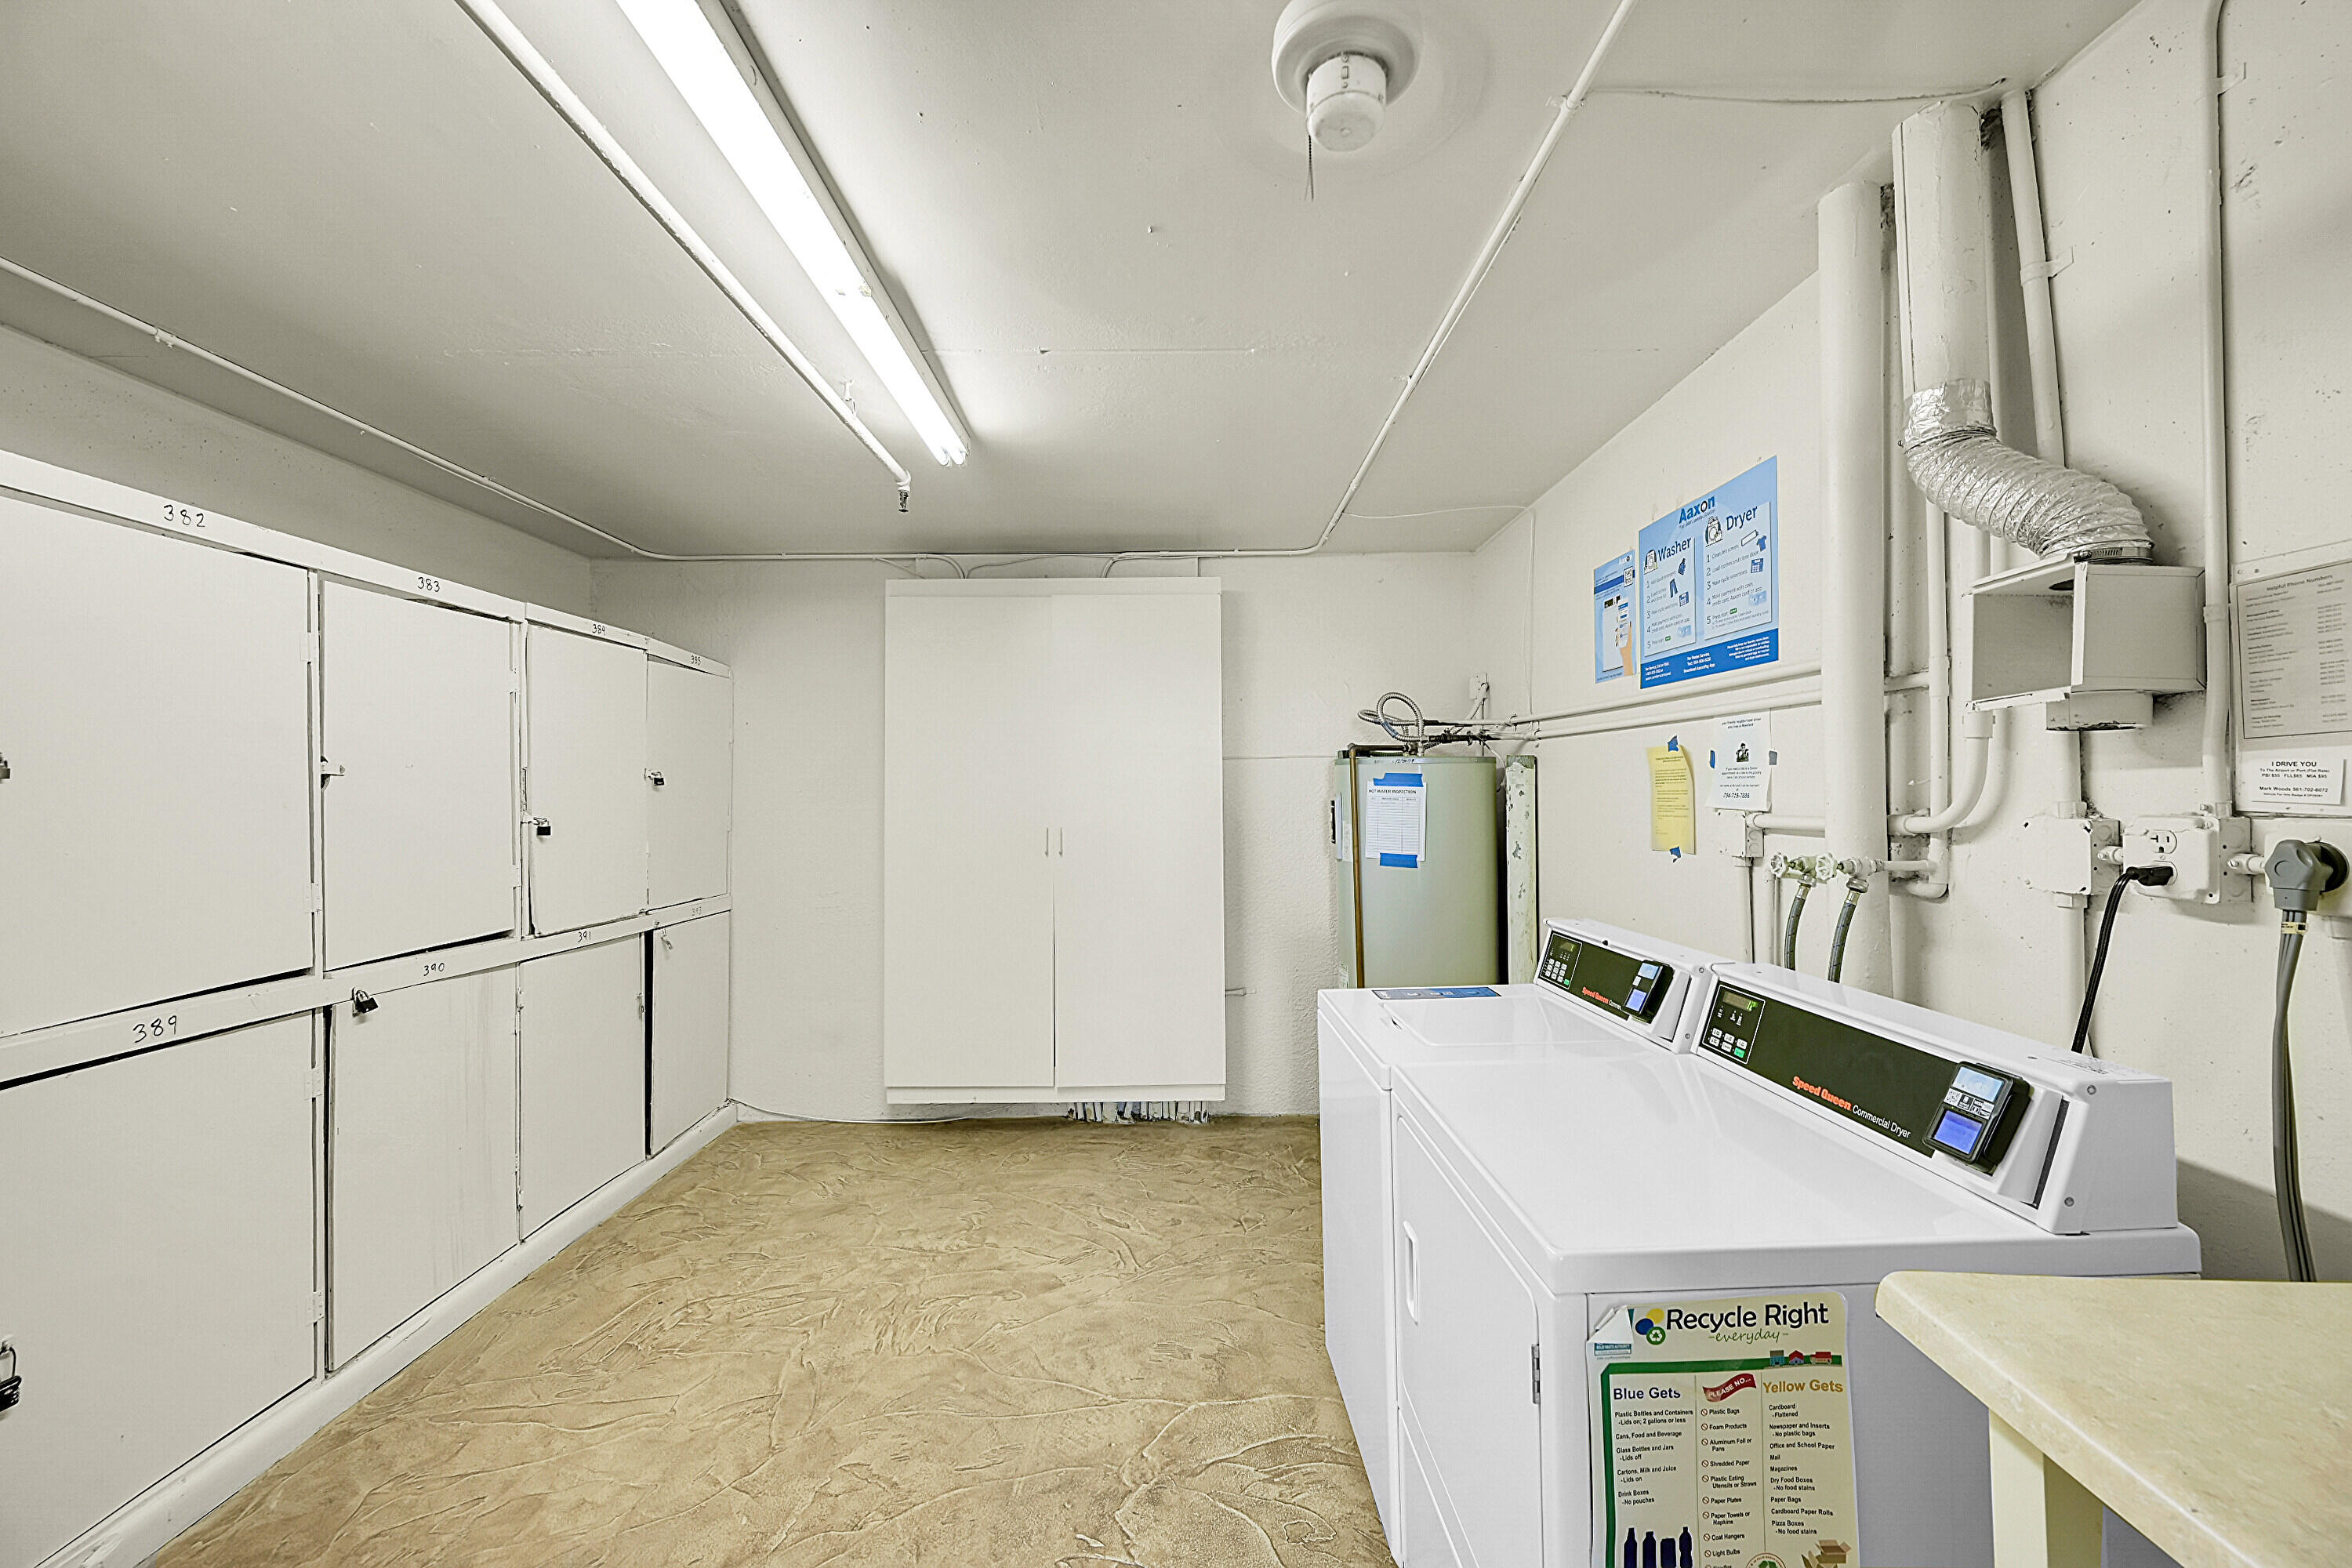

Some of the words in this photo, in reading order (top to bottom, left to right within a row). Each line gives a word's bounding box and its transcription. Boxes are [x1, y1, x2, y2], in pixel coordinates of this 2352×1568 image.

[163, 504, 205, 527] 382
[1679, 495, 1715, 524] Aaxon
[1726, 506, 1758, 531] Dryer
[1658, 537, 1692, 561] Washer
[1707, 554, 1710, 563] 1
[1706, 567, 1711, 576] 2
[418, 577, 440, 592] 383
[1706, 580, 1711, 590] 3
[2307, 575, 2332, 583] Numbers
[1706, 615, 1711, 625] 5
[592, 624, 606, 635] 384
[578, 930, 592, 942] 391
[423, 963, 445, 977] 390
[132, 1015, 177, 1043] 389
[1792, 1075, 1821, 1097] Speed
[1820, 1088, 1852, 1111] Queen
[1853, 1104, 1891, 1130] Commercial
[1890, 1122, 1911, 1139] Dryer
[1666, 1305, 1757, 1334] Recycle
[1765, 1301, 1829, 1329] Right
[1708, 1384, 1734, 1397] PLEASE
[1762, 1381, 1806, 1393] Yellow
[1809, 1379, 1844, 1392] Gets
[1613, 1388, 1644, 1400] Blue
[1649, 1387, 1681, 1399] Gets
[1632, 1497, 1655, 1506] pouches
